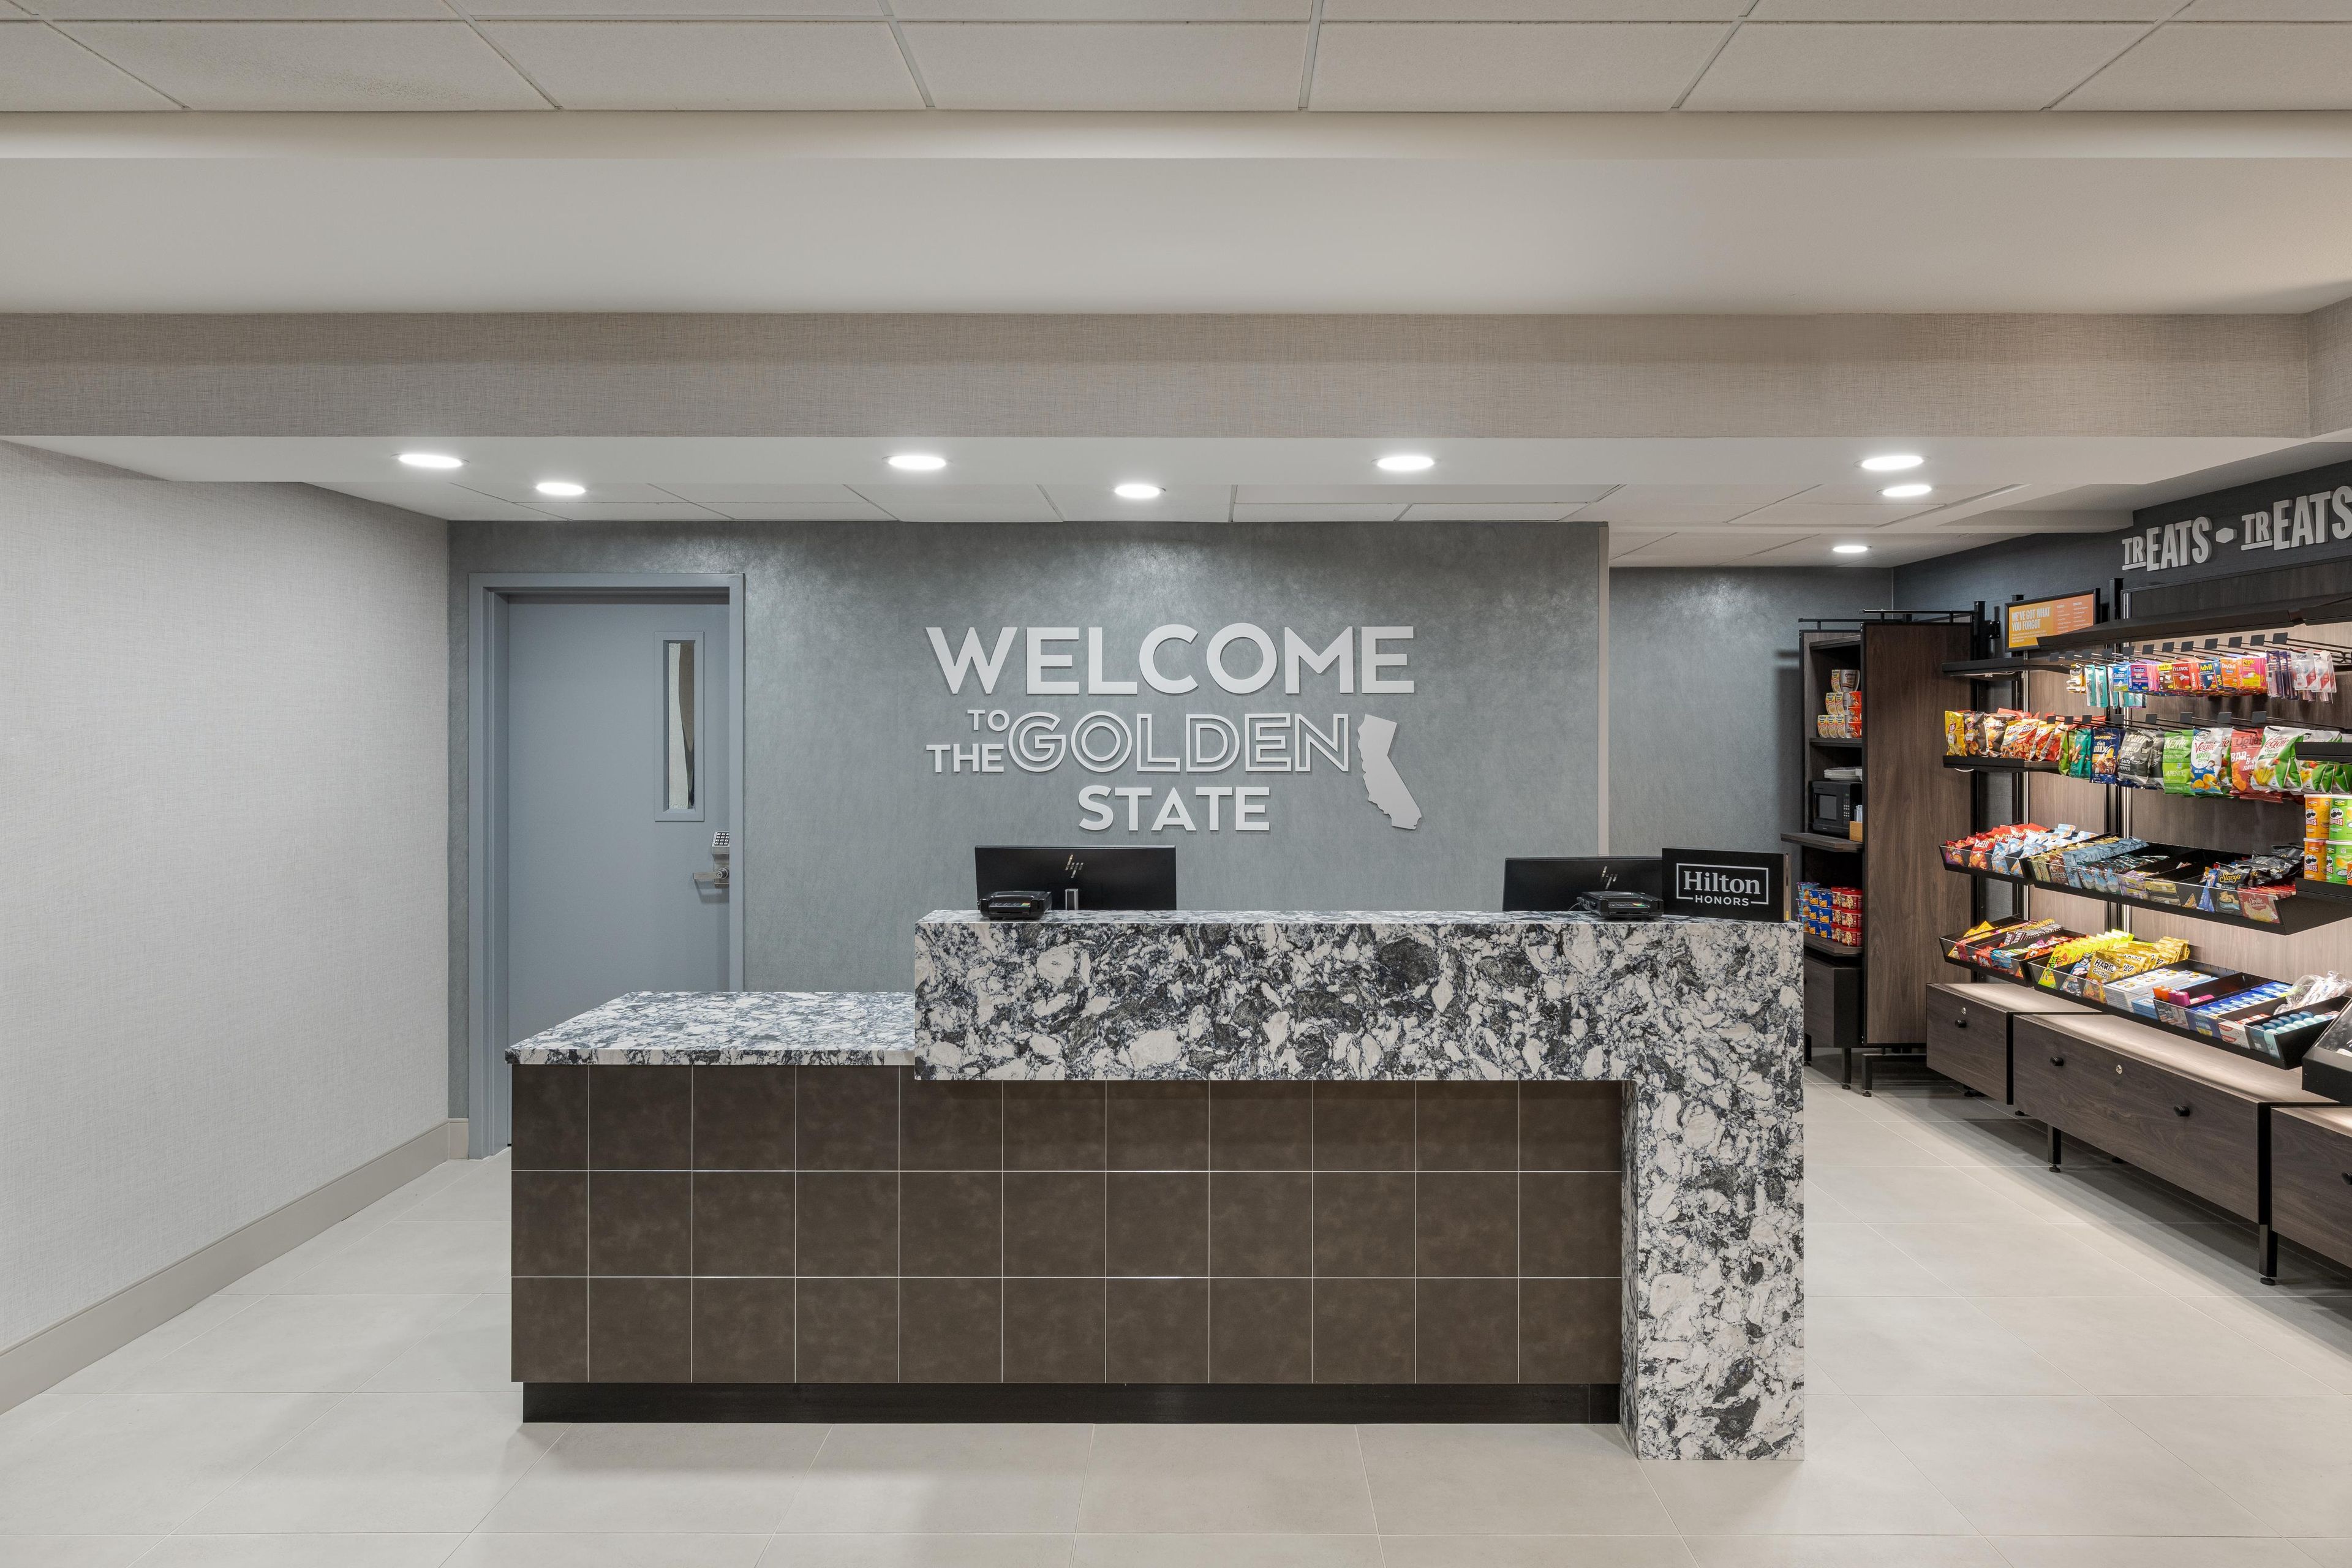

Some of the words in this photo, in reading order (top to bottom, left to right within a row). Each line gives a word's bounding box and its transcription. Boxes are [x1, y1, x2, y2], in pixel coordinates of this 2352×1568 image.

[2122, 516, 2212, 571] TREATS
[2241, 486, 2352, 551] TREATS
[2011, 610, 2026, 622] WE'VE
[2026, 609, 2036, 619] GOT
[2037, 607, 2051, 618] WHAT
[2012, 621, 2022, 631] YOU
[2022, 619, 2041, 630] FORGOT
[925, 622, 1415, 695] WELCOME
[967, 709, 1009, 732] TO
[926, 744, 1005, 774] THE
[1008, 710, 1349, 774] GOLDEN
[1078, 785, 1270, 832] STATE
[1683, 870, 1761, 895] Hilton
[1695, 894, 1750, 907] HONORS
